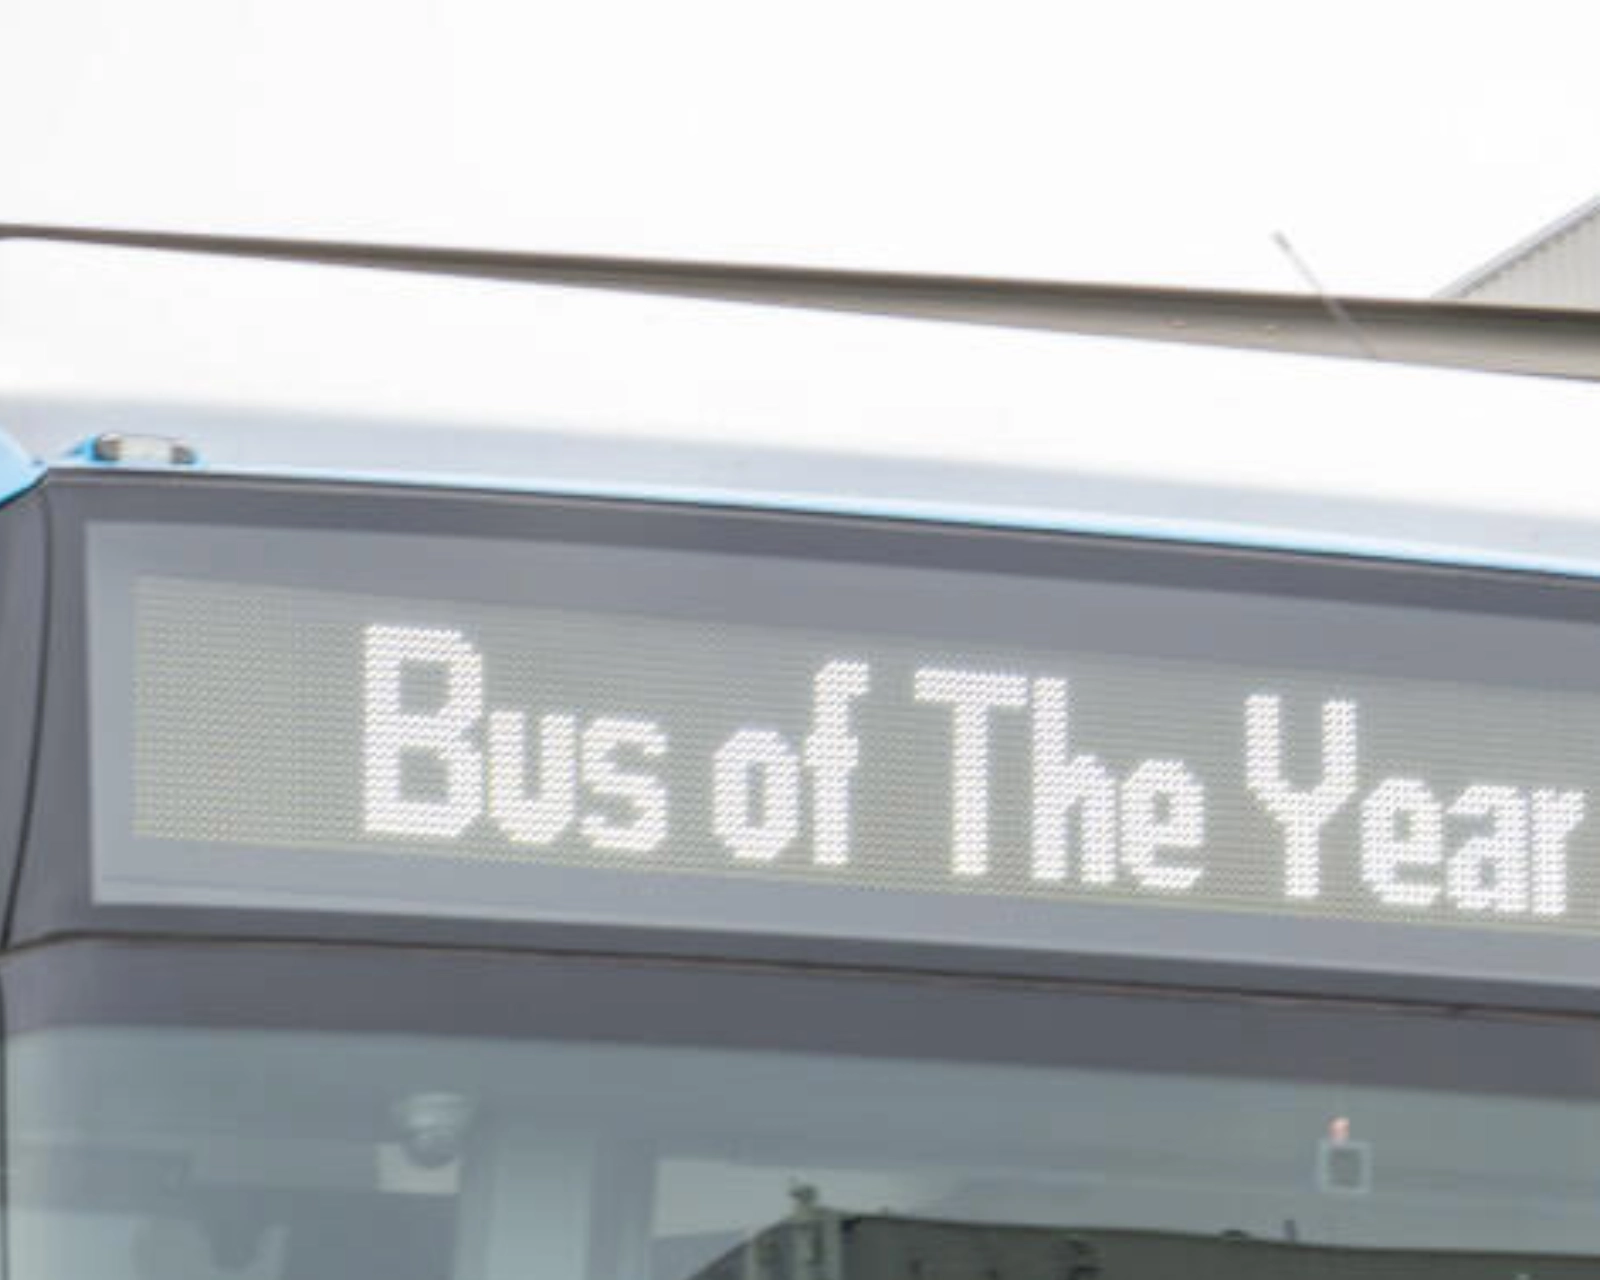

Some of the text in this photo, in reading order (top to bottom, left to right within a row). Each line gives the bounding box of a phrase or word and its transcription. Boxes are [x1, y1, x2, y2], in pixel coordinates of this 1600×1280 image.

[362, 623, 1587, 917] Bus of The Year
